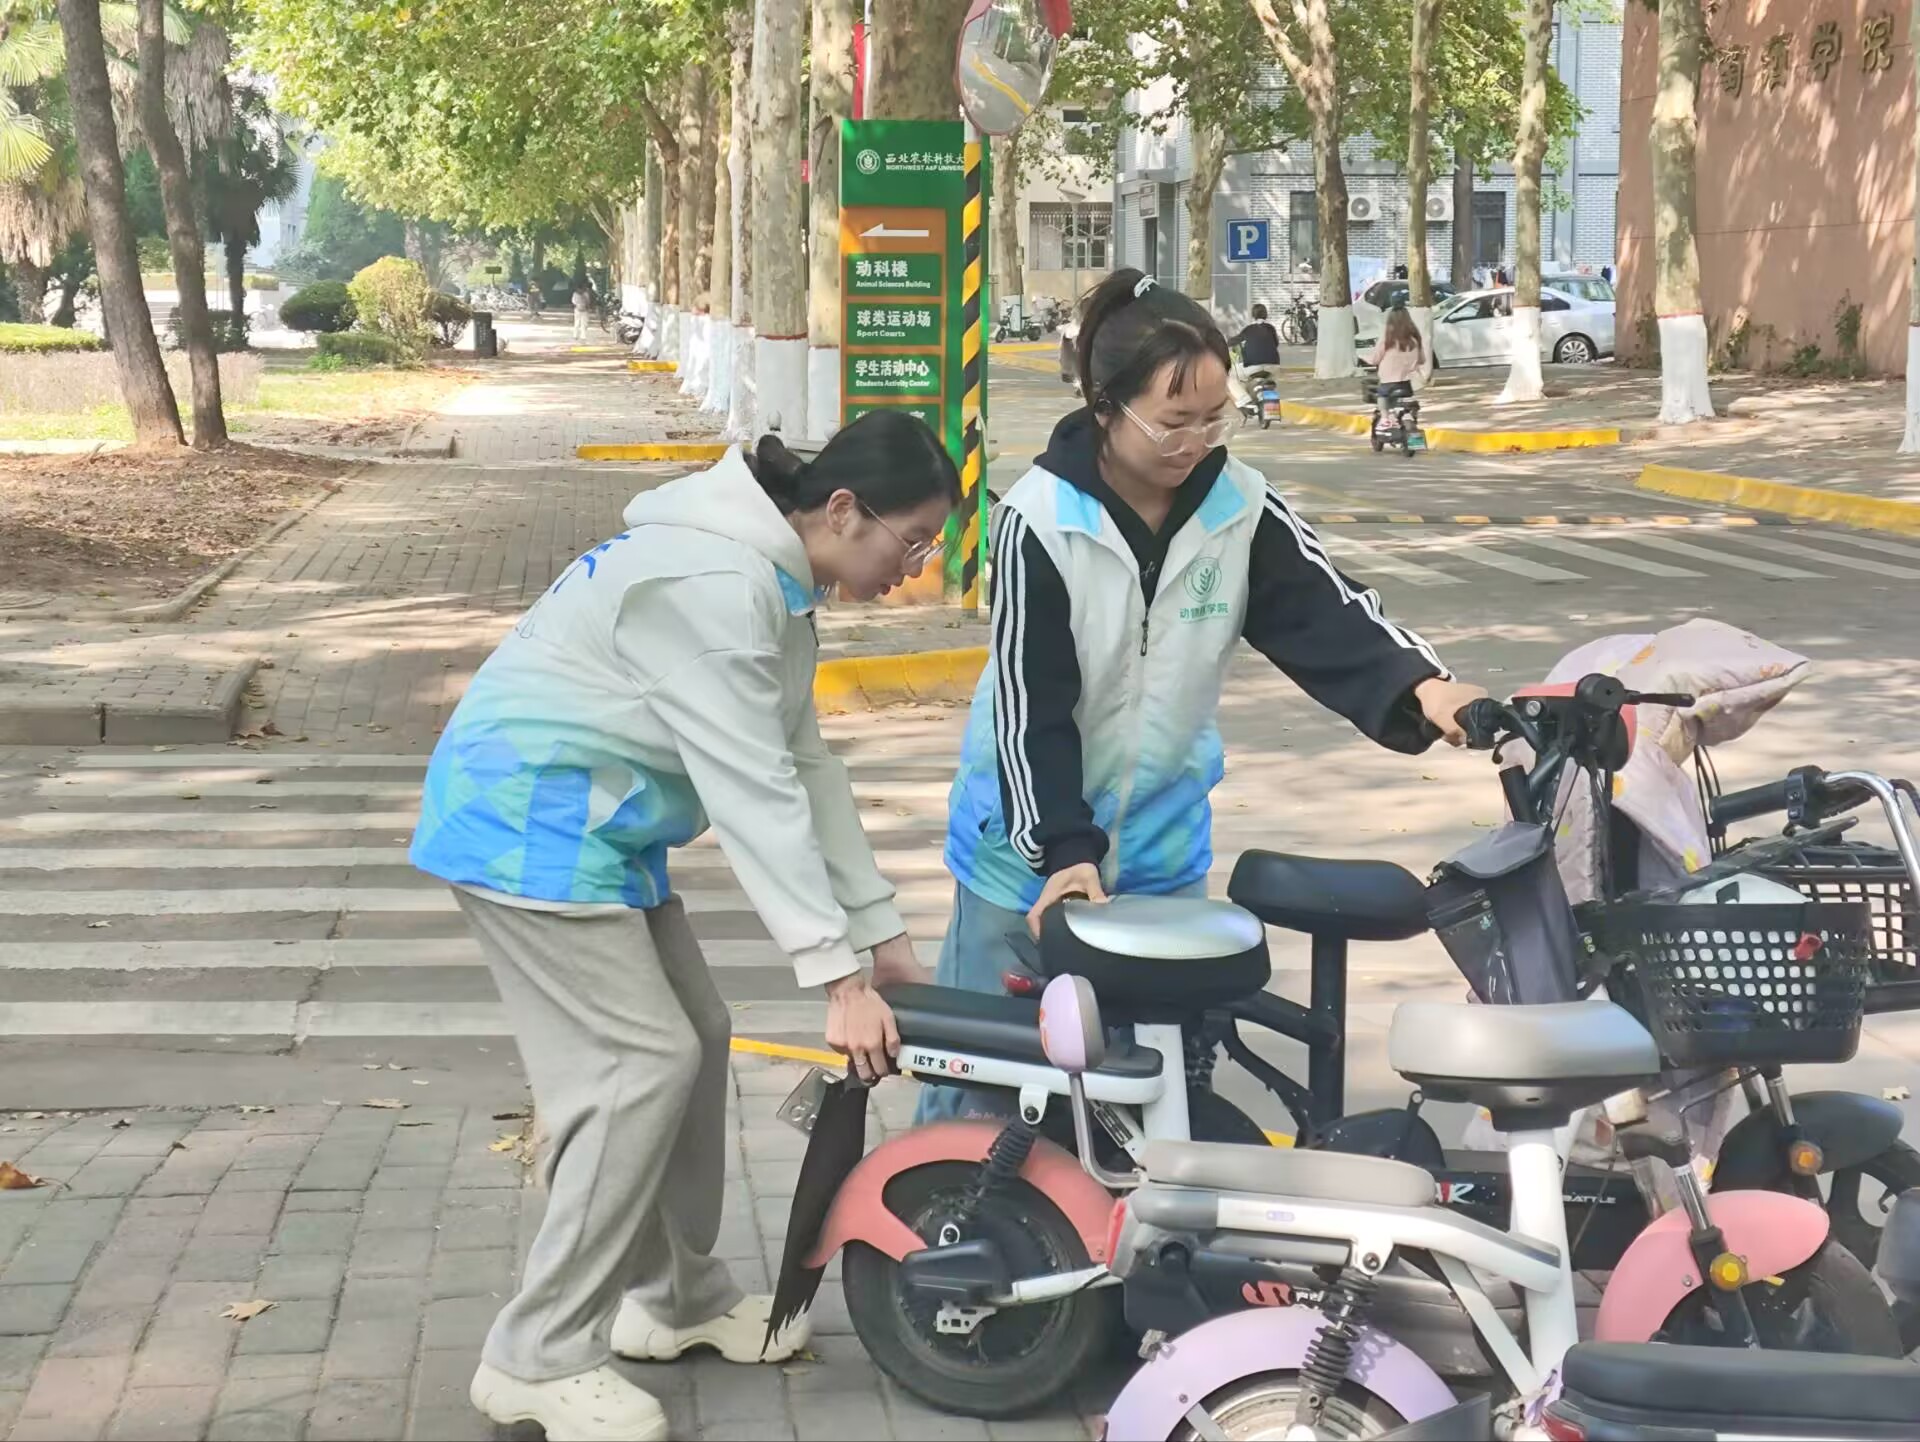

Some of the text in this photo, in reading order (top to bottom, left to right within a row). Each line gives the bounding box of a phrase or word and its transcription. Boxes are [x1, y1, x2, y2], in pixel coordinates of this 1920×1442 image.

[885, 151, 965, 164] 西北农林科技大
[1237, 225, 1260, 256] P
[855, 260, 908, 277] 动科楼
[855, 280, 878, 288] Animal
[905, 280, 931, 289] Building
[856, 309, 932, 327] 球类运动场
[856, 329, 906, 338] Sport Courts
[855, 359, 930, 377] 学生活动中心
[855, 379, 930, 388] Students Activity Center
